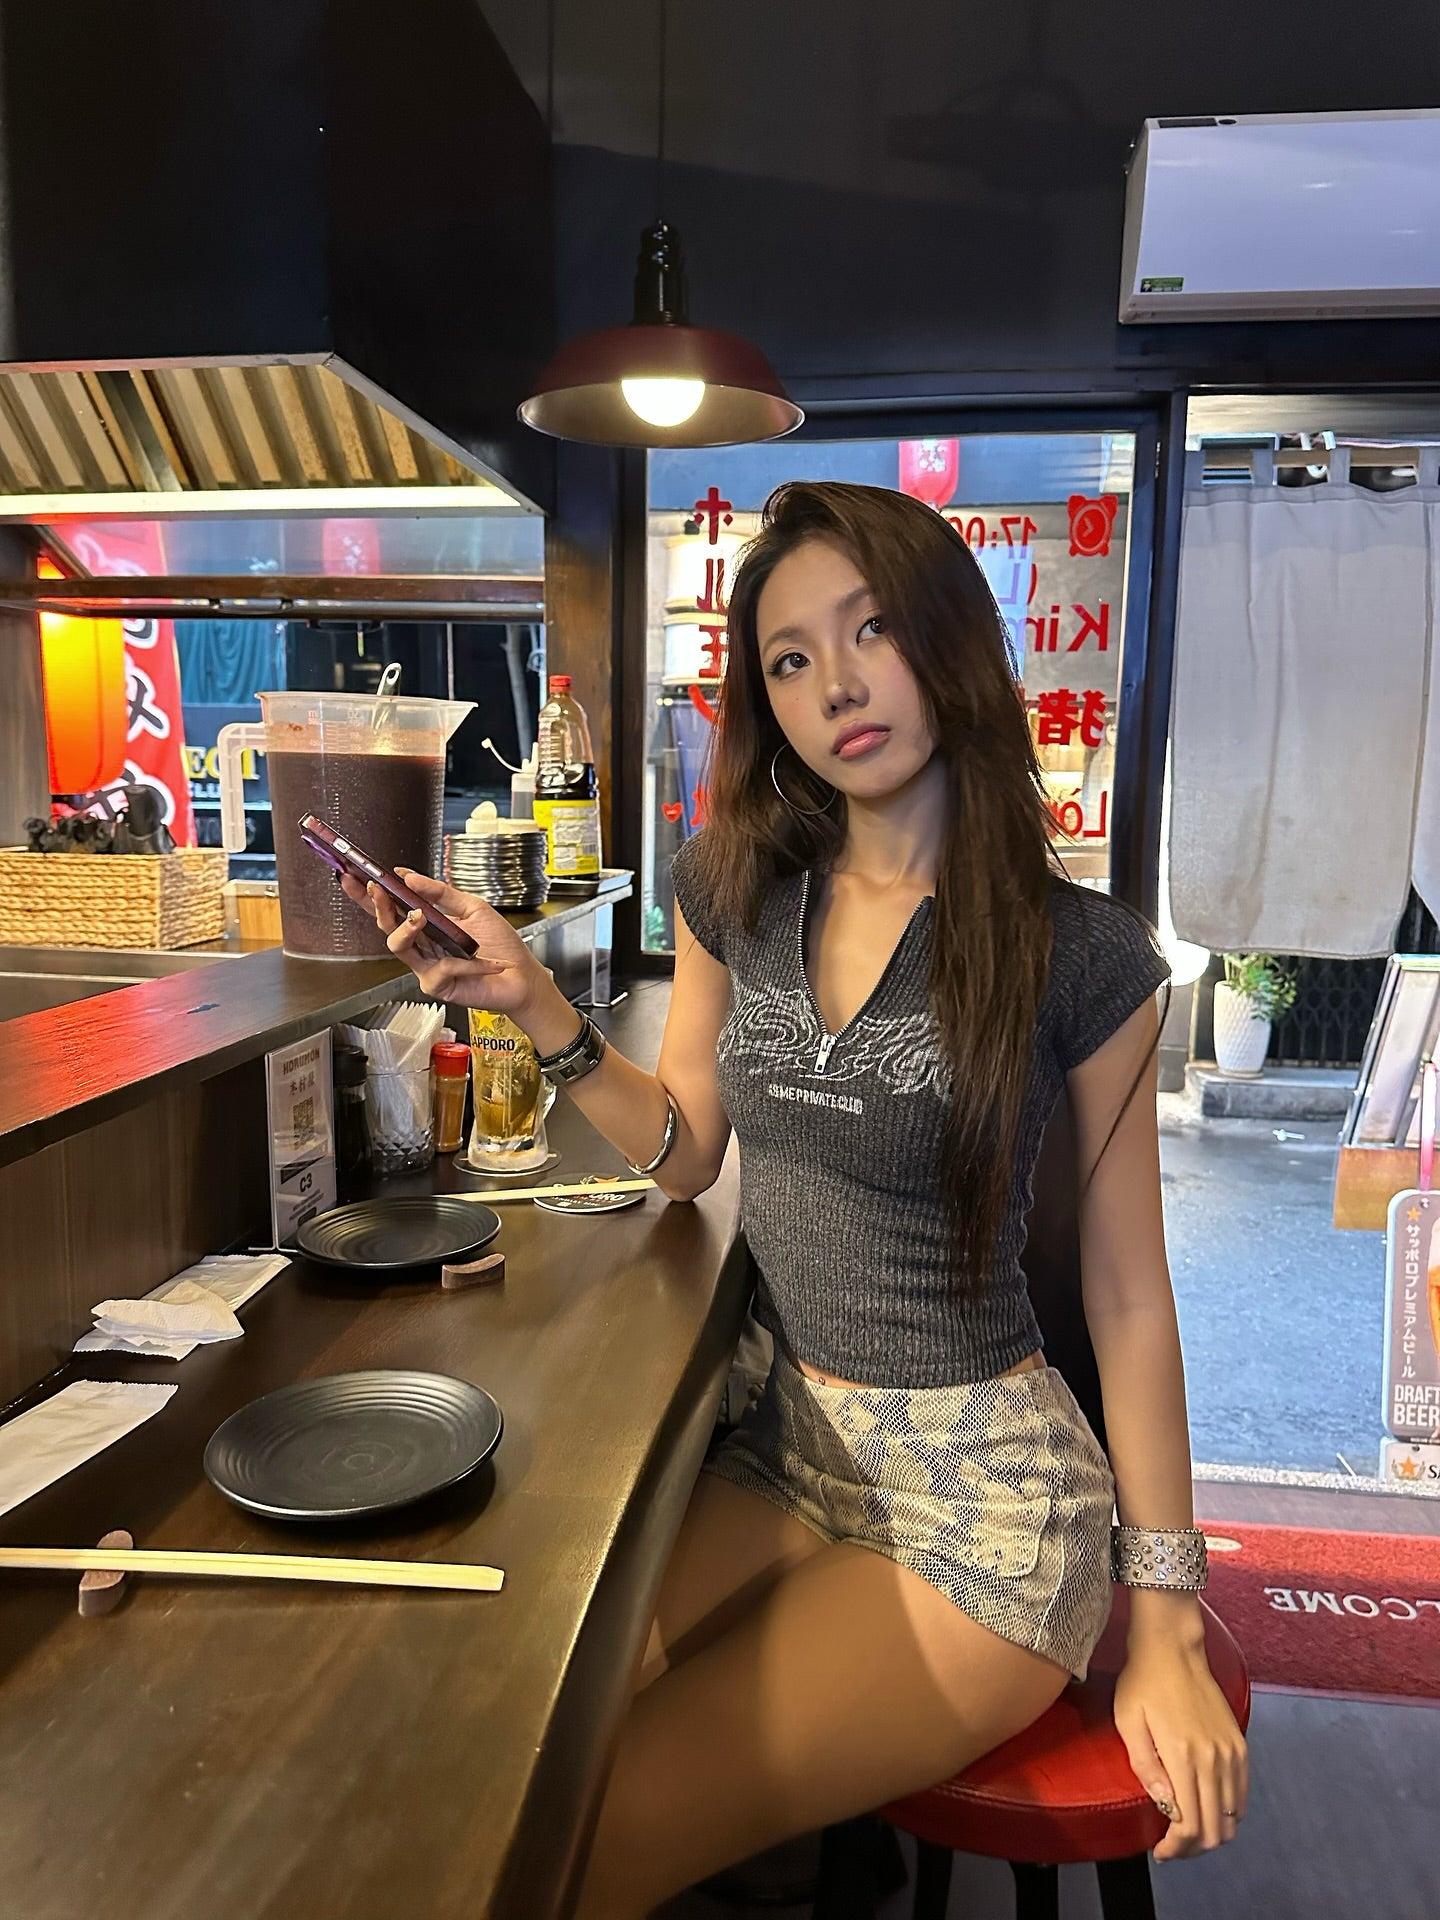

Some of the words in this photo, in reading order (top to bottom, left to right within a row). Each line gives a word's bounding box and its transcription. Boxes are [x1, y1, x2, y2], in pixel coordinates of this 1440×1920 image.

[471, 1035, 516, 1051] APPORO
[299, 1172, 313, 1194] C3
[1394, 1383, 1440, 1405] DRAFT
[1393, 1402, 1440, 1427] BEER
